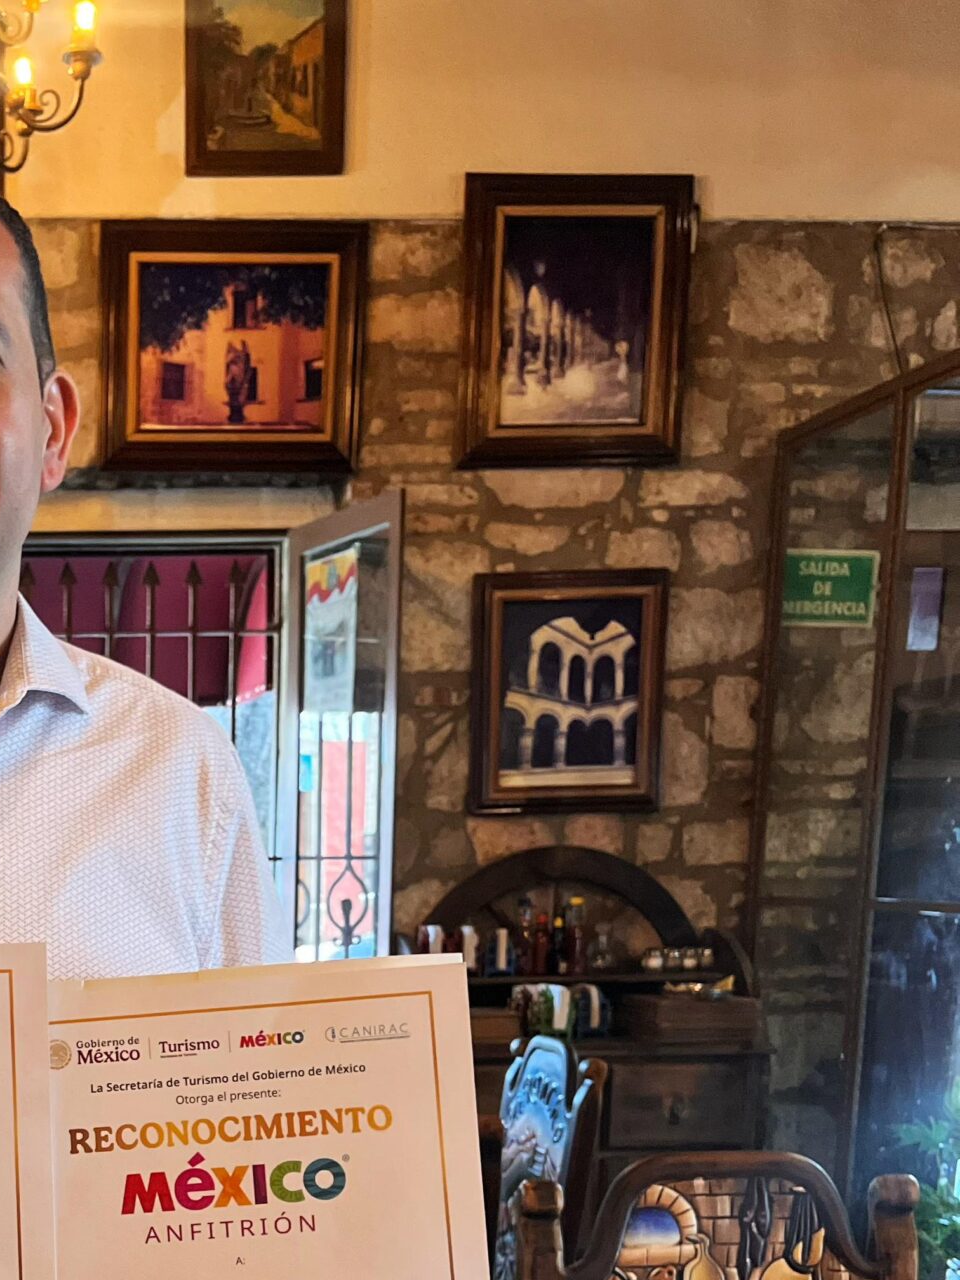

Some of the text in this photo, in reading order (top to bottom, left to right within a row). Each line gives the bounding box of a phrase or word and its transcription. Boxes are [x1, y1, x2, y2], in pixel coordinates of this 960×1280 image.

[799, 561, 850, 576] SALIDA
[812, 581, 832, 596] DE
[340, 1023, 408, 1038] CANIRAC
[76, 1037, 140, 1049] Gobierno de
[159, 1039, 220, 1053] Turismo
[77, 1047, 140, 1065] México
[91, 1064, 366, 1093] La Secretaría de Turismo del Gobierno de México
[175, 1088, 281, 1105] Otorga el presente:
[69, 1104, 393, 1154] RECONOCIMIENTO
[144, 1211, 317, 1244] ANFITRIÓN
[236, 1256, 246, 1265] A:
